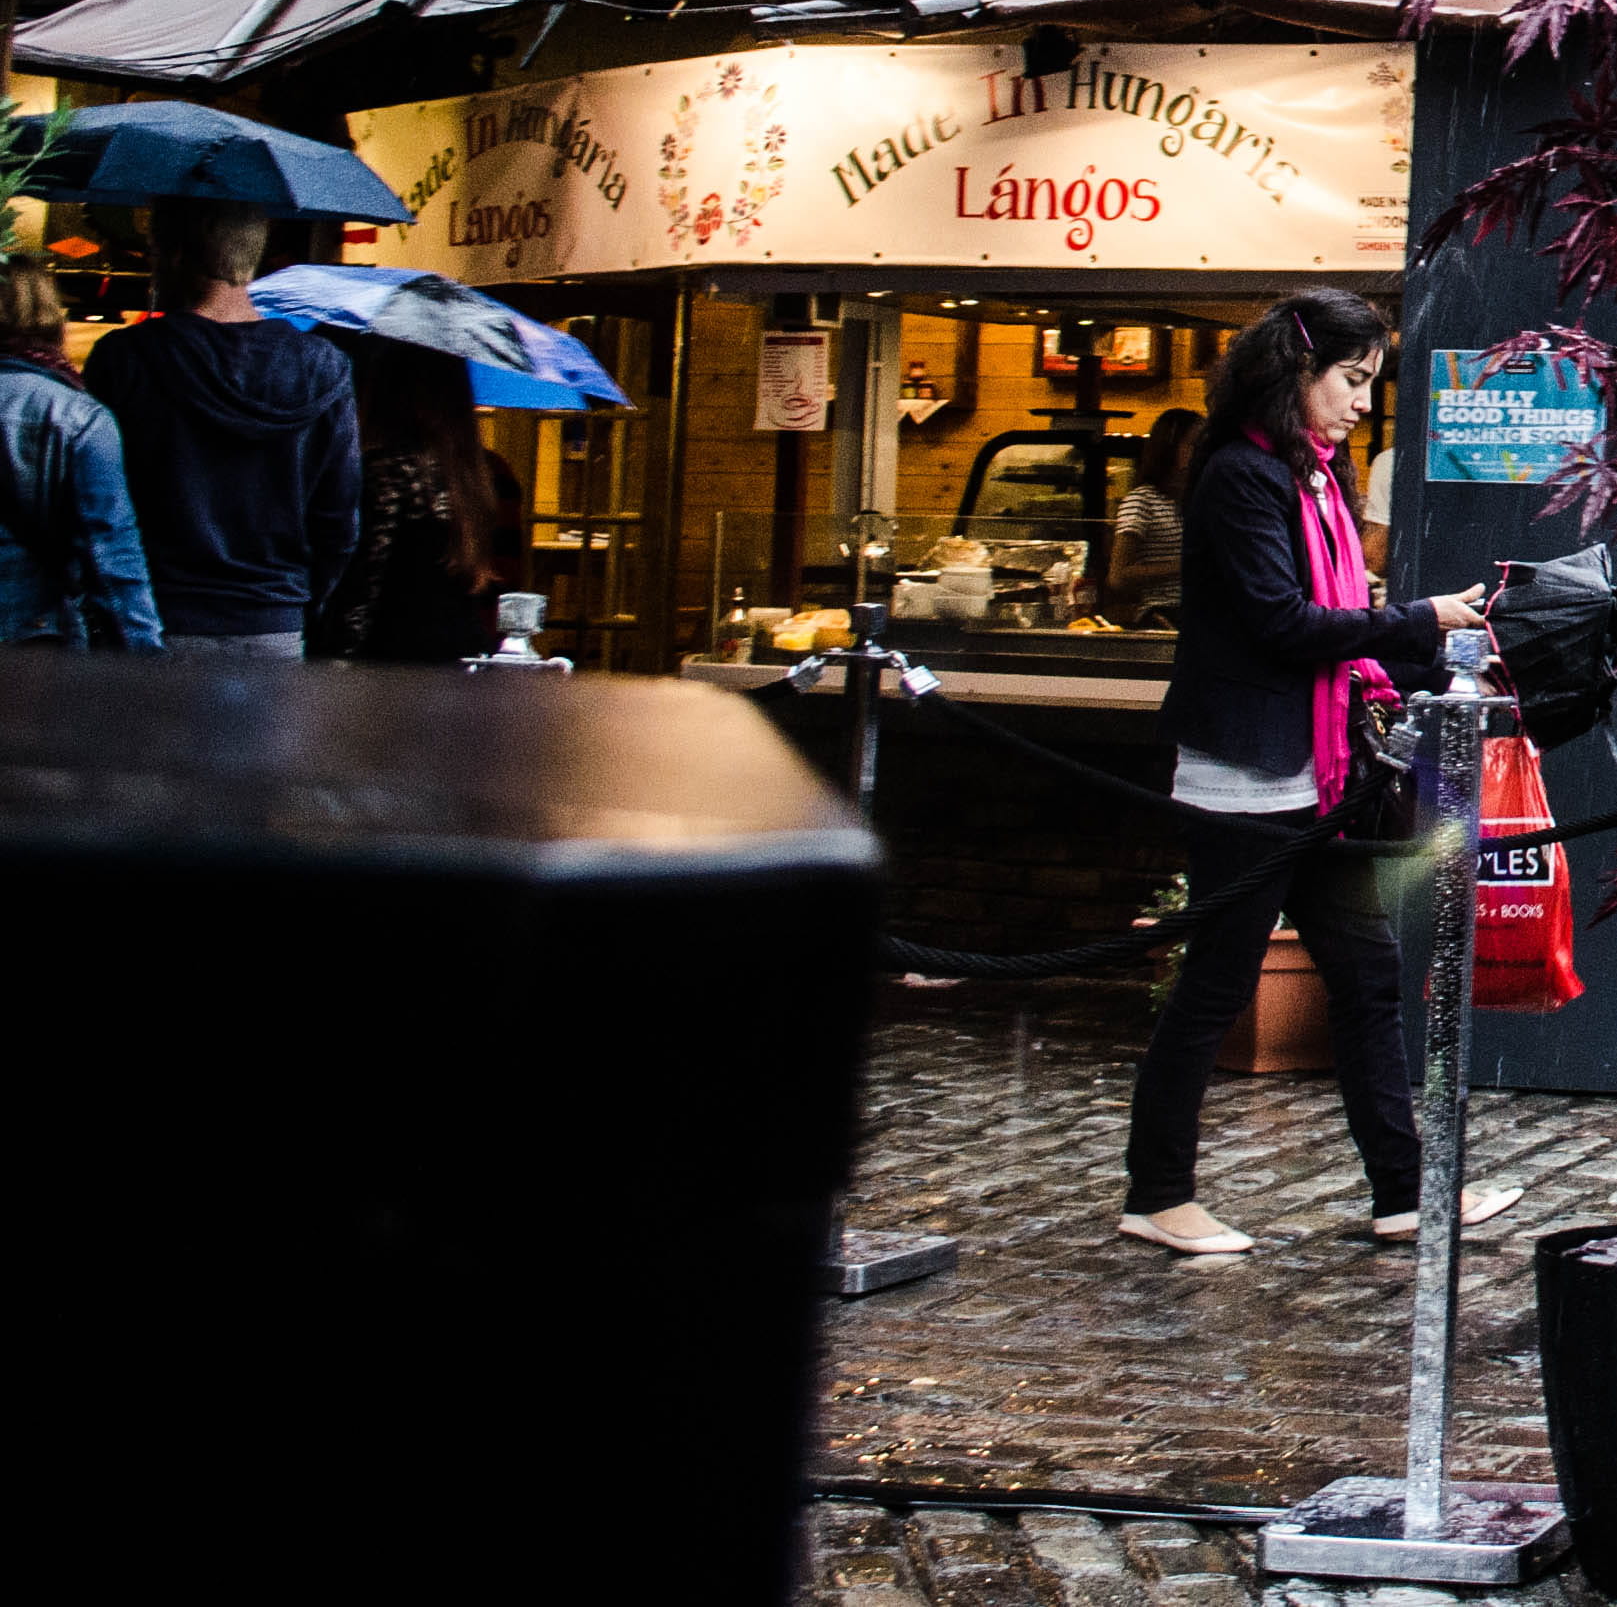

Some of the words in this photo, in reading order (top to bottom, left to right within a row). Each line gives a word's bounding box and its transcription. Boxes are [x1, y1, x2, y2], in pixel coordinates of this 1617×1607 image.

[829, 106, 962, 207] Made
[978, 69, 1048, 126] In
[1066, 60, 1301, 205] Hungária
[954, 162, 1162, 252] Lángos
[450, 190, 552, 269] Lángos
[1438, 389, 1539, 409] REALLY
[1437, 407, 1504, 424] GOOD
[1507, 408, 1596, 426] THINGS
[1476, 846, 1540, 876] YLES
[1500, 903, 1545, 919] BOOKS
